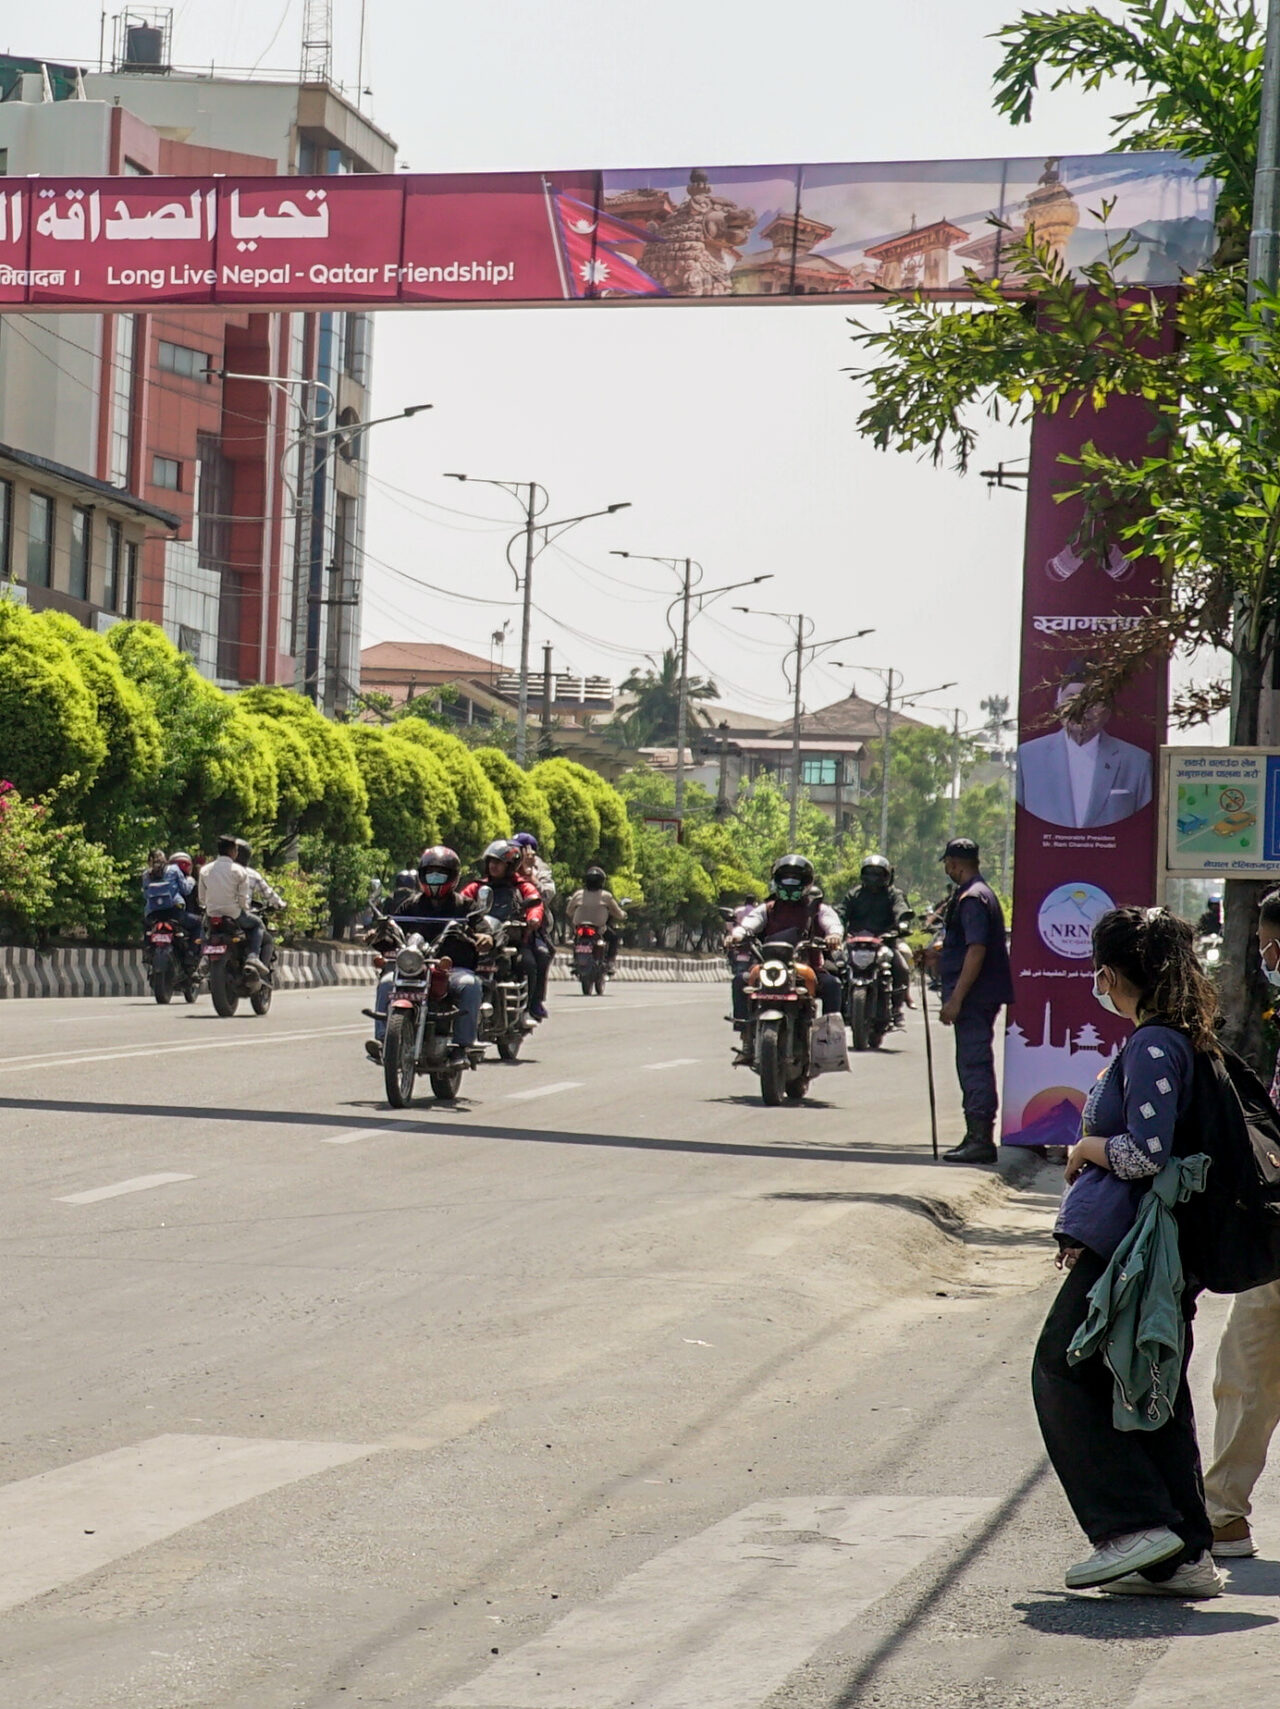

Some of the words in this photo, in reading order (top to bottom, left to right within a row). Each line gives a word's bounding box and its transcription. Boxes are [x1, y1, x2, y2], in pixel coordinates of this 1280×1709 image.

[36, 189, 216, 243] الصداقة
[230, 188, 329, 252] تحيا
[107, 266, 165, 289] Long
[170, 263, 218, 285] Live
[222, 263, 290, 288] Nepal
[309, 263, 379, 285] Qatar
[383, 261, 514, 286] Friendship!
